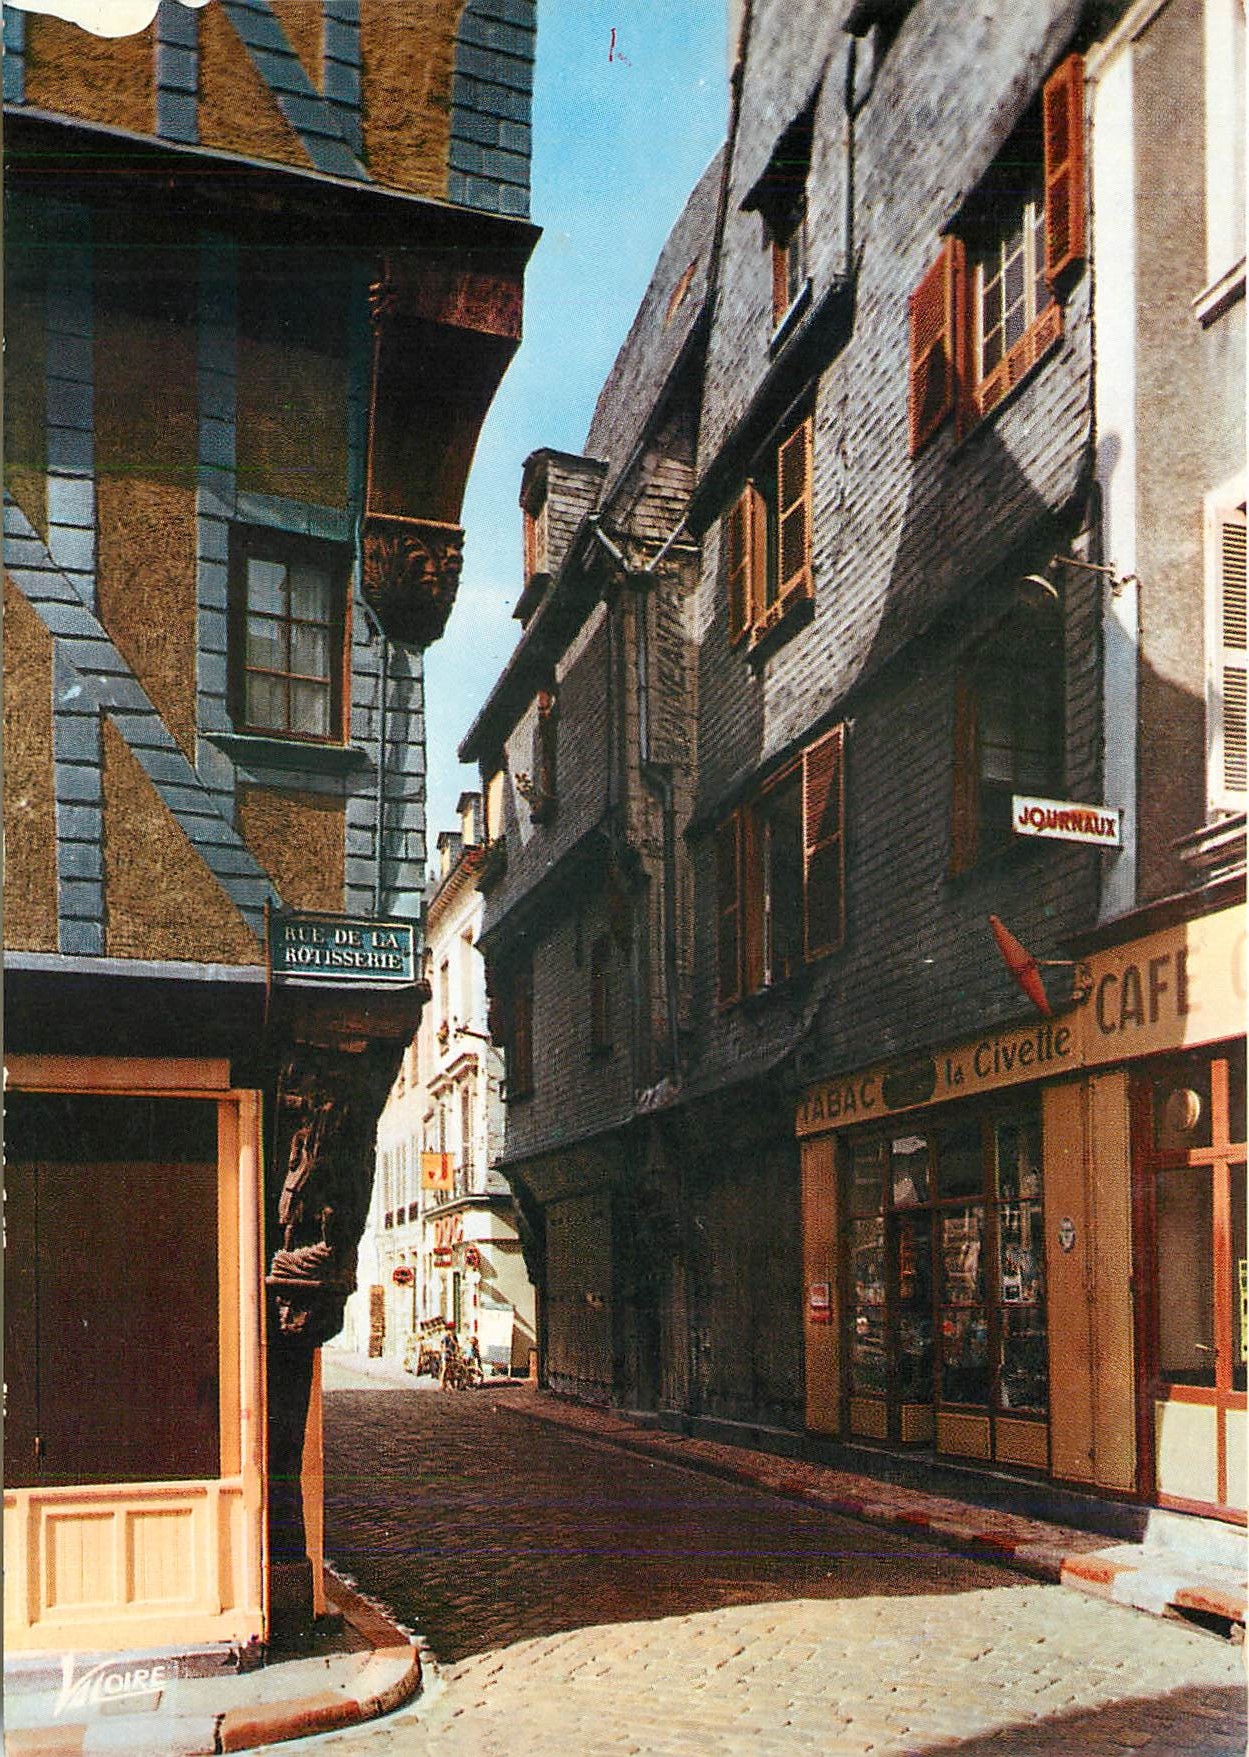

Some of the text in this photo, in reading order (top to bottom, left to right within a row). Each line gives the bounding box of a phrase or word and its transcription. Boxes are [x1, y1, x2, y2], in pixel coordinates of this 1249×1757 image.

[1018, 806, 1116, 837] JOURNAUX
[285, 926, 399, 949] RUE DE LA
[973, 1024, 1072, 1078] Civette
